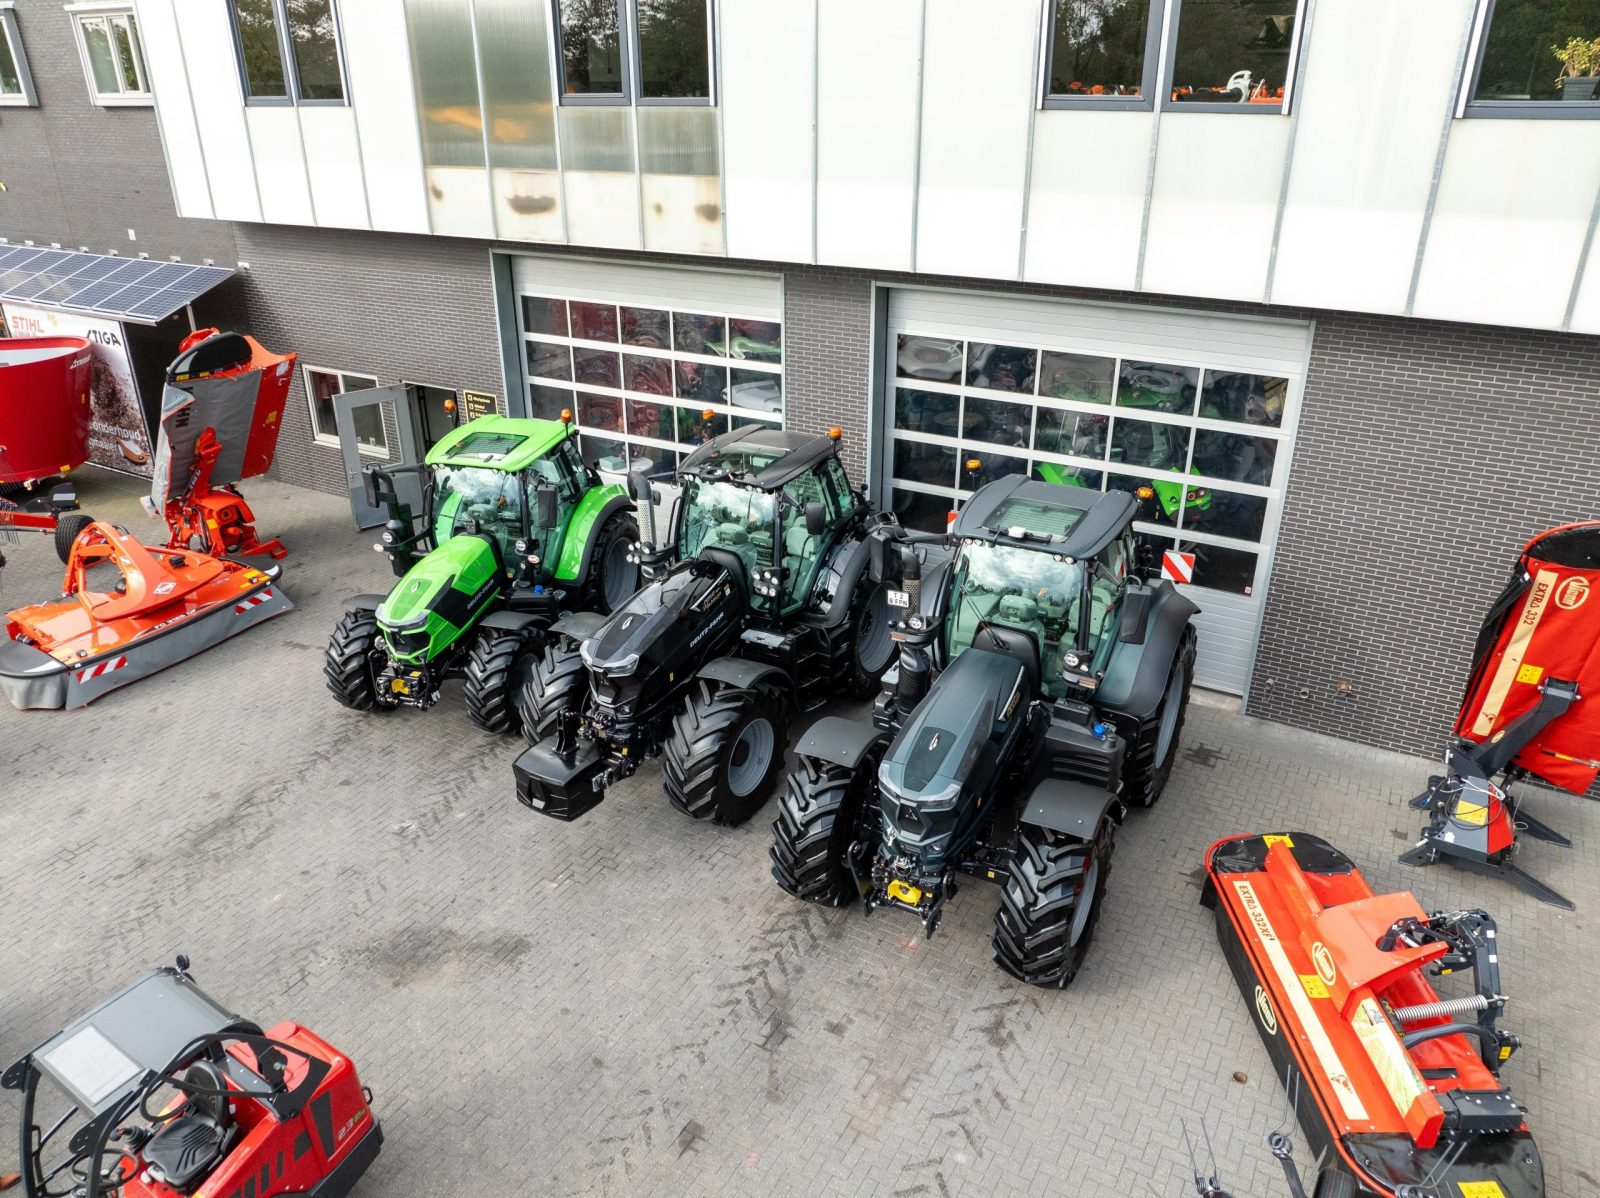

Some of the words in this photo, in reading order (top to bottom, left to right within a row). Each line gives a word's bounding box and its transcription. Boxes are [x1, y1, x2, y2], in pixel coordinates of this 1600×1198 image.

[11, 316, 45, 333] STIHL
[1529, 582, 1549, 608] EXTRA
[1522, 609, 1538, 626] 332
[1238, 884, 1256, 911] EXTRA
